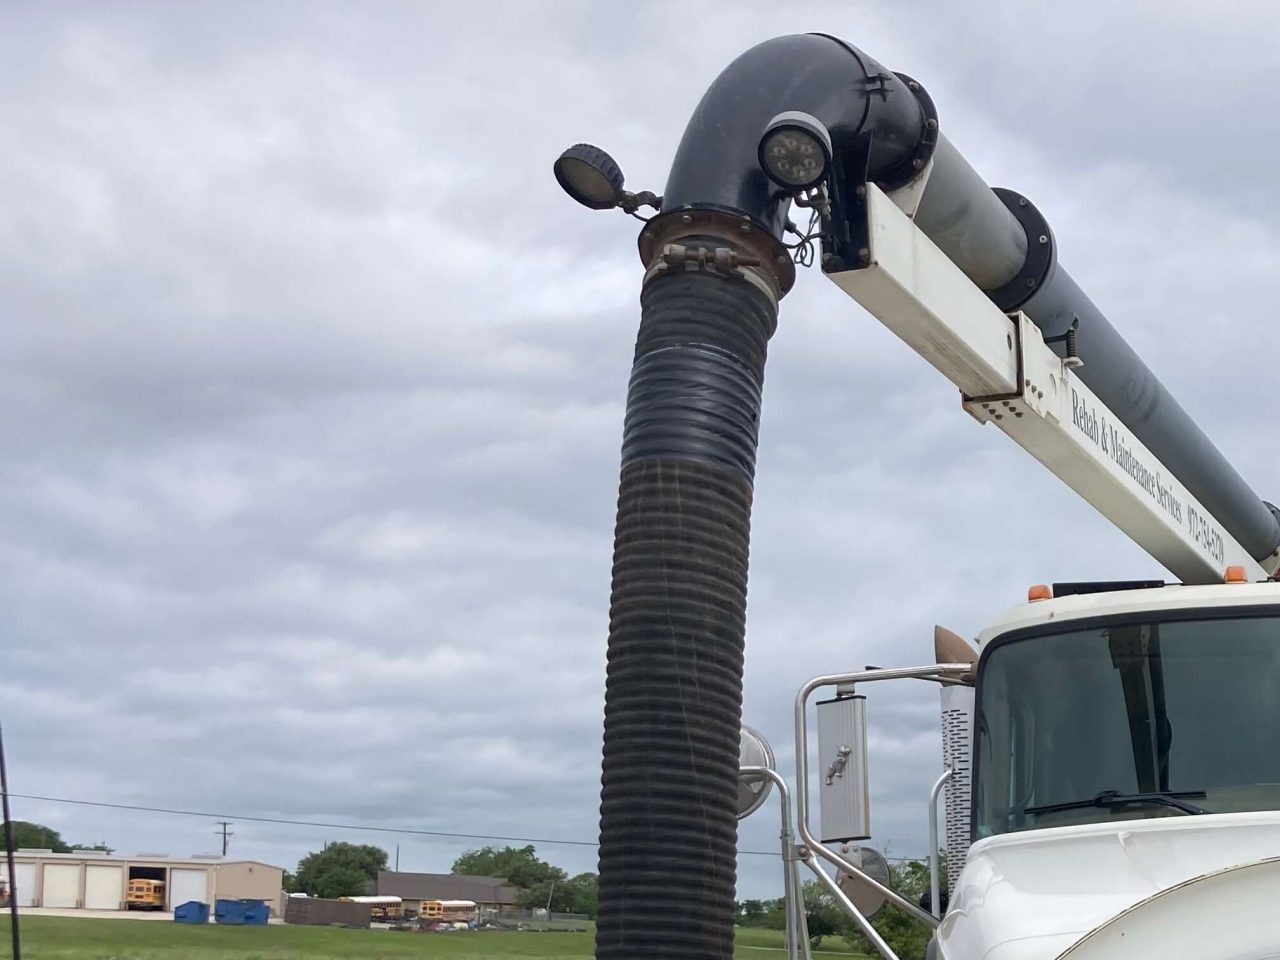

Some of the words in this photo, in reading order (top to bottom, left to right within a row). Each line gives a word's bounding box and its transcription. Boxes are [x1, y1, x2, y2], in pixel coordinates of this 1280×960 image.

[1071, 387, 1099, 446] Rehab
[1101, 416, 1108, 454] &
[1109, 424, 1156, 498] Maintenance
[1156, 470, 1183, 524] Services
